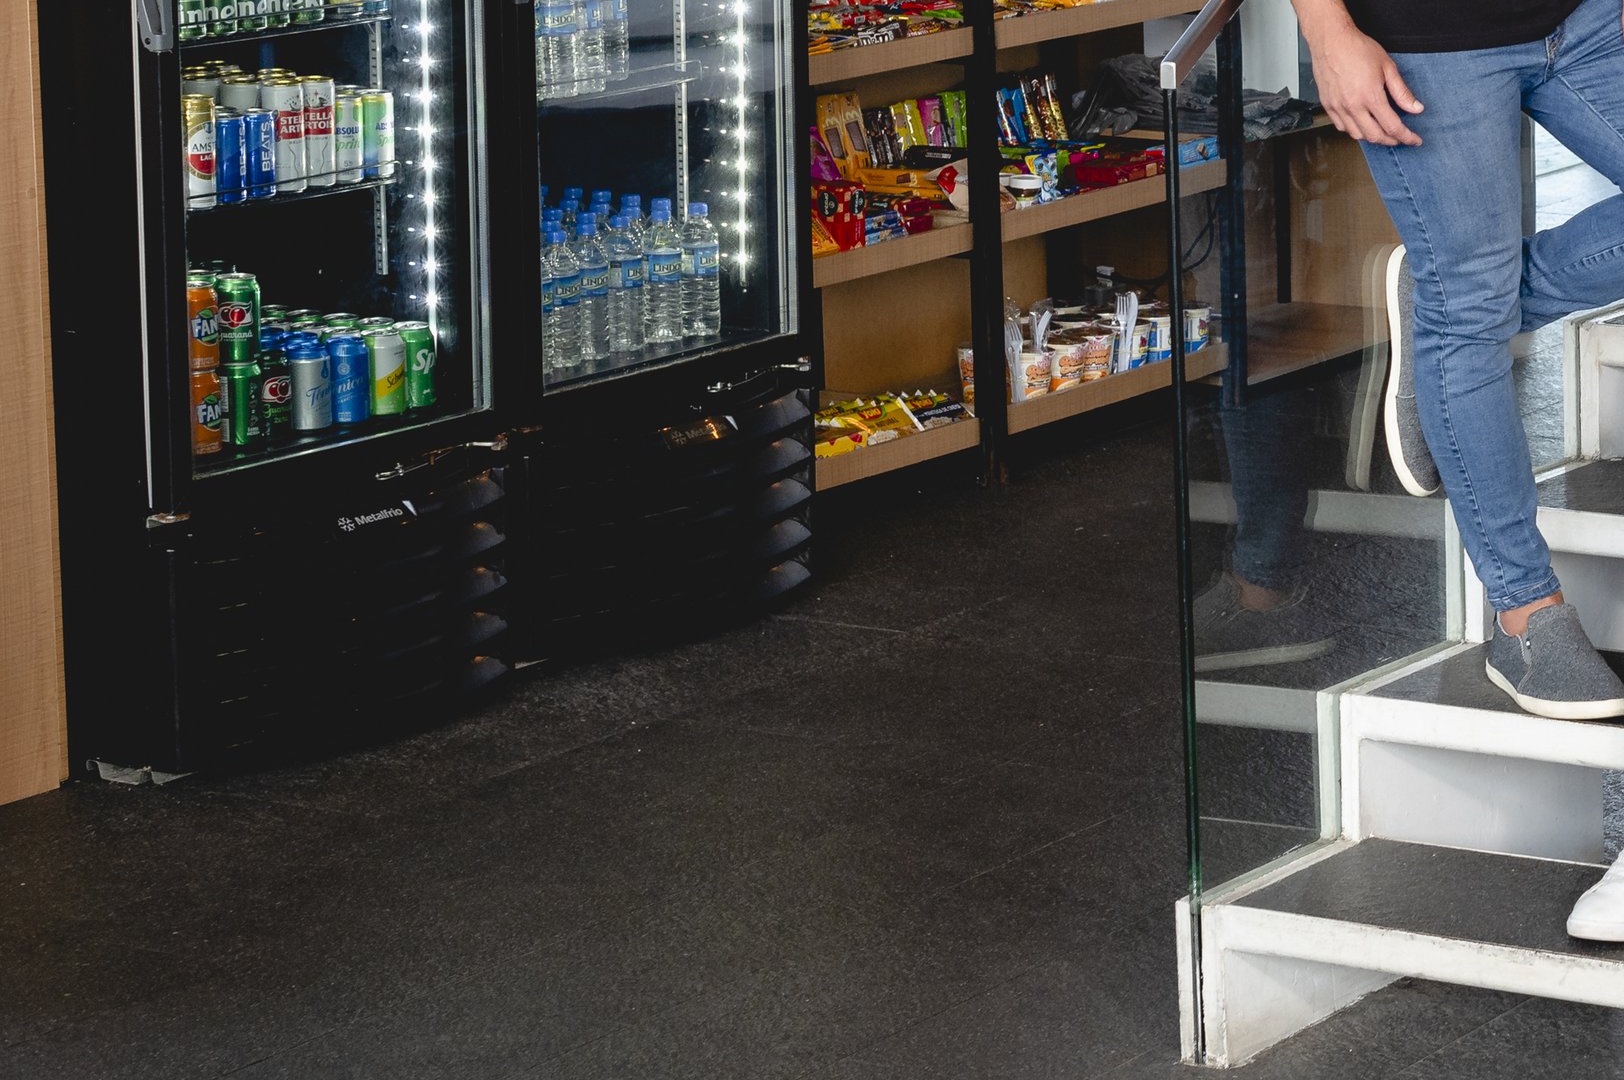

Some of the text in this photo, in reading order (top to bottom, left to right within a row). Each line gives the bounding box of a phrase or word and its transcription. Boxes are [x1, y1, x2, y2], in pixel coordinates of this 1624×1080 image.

[261, 121, 271, 172] BEATS
[192, 316, 218, 338] FAN
[412, 348, 435, 375] Sp
[196, 403, 221, 424] FAN
[354, 505, 403, 527] Metalfrio
